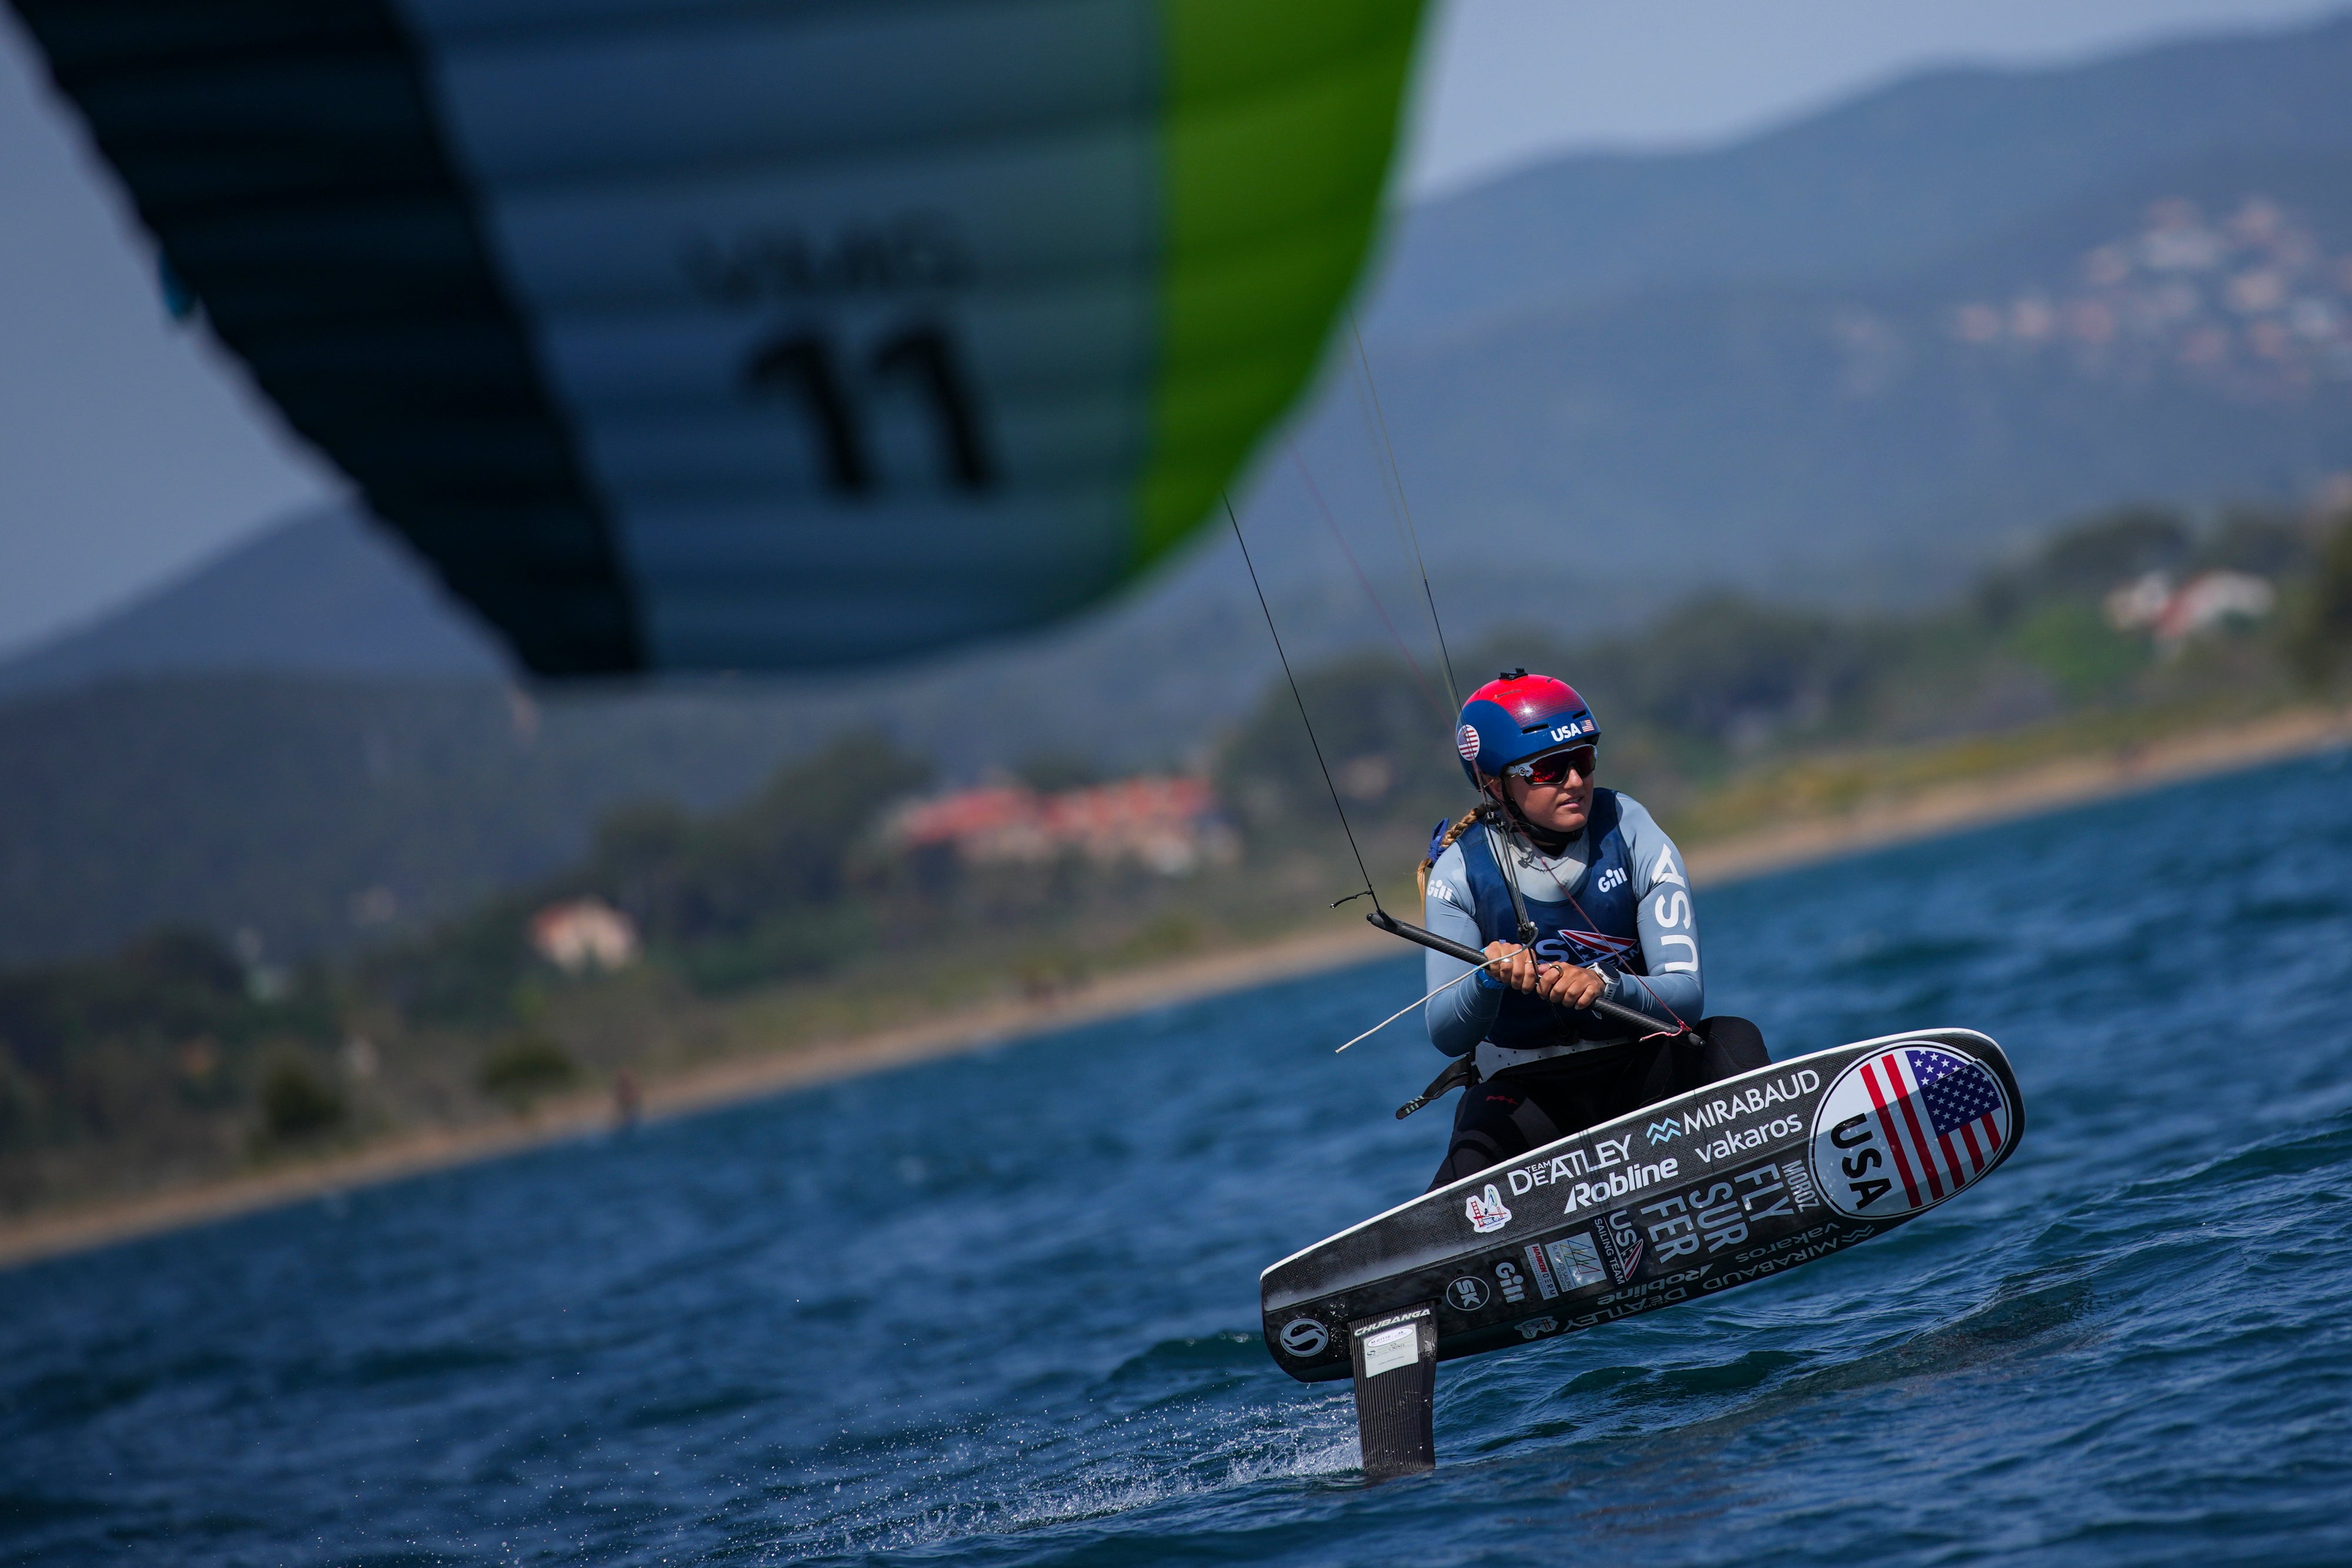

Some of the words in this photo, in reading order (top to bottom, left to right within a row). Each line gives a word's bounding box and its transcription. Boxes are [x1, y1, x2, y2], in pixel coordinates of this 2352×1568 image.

[742, 325, 997, 497] 11
[1551, 723, 1582, 741] USA
[1427, 880, 1453, 901] Gill
[1598, 867, 1628, 892] Gill
[1651, 843, 1699, 972] USA
[1607, 942, 1642, 968] EAM
[1683, 1069, 1820, 1135] MIRABAUD
[1695, 1114, 1803, 1163] vakaros
[1830, 1112, 1892, 1210] USA
[1525, 1160, 1552, 1174] TEAM
[1563, 1158, 1679, 1215] Robline
[1782, 1159, 1820, 1213] MOROZ
[1734, 1163, 1795, 1222] FLY
[1609, 1209, 1637, 1246] US
[1640, 1195, 1700, 1264] FER
[1689, 1182, 1749, 1253] SUR
[1735, 1222, 1840, 1262] vakaros
[1532, 1246, 1548, 1273] HARKEN
[1542, 1272, 1556, 1296] DERM
[1595, 1218, 1615, 1256] SAILING
[1609, 1257, 1625, 1285] TEAM
[1703, 1237, 1838, 1289] MIRABAUD
[1455, 1279, 1481, 1308] SK
[1495, 1262, 1525, 1303] Gill
[1563, 1271, 1573, 1289] SAILING
[1596, 1263, 1715, 1306] Robline
[1354, 1308, 1431, 1336] CHUBANGA
